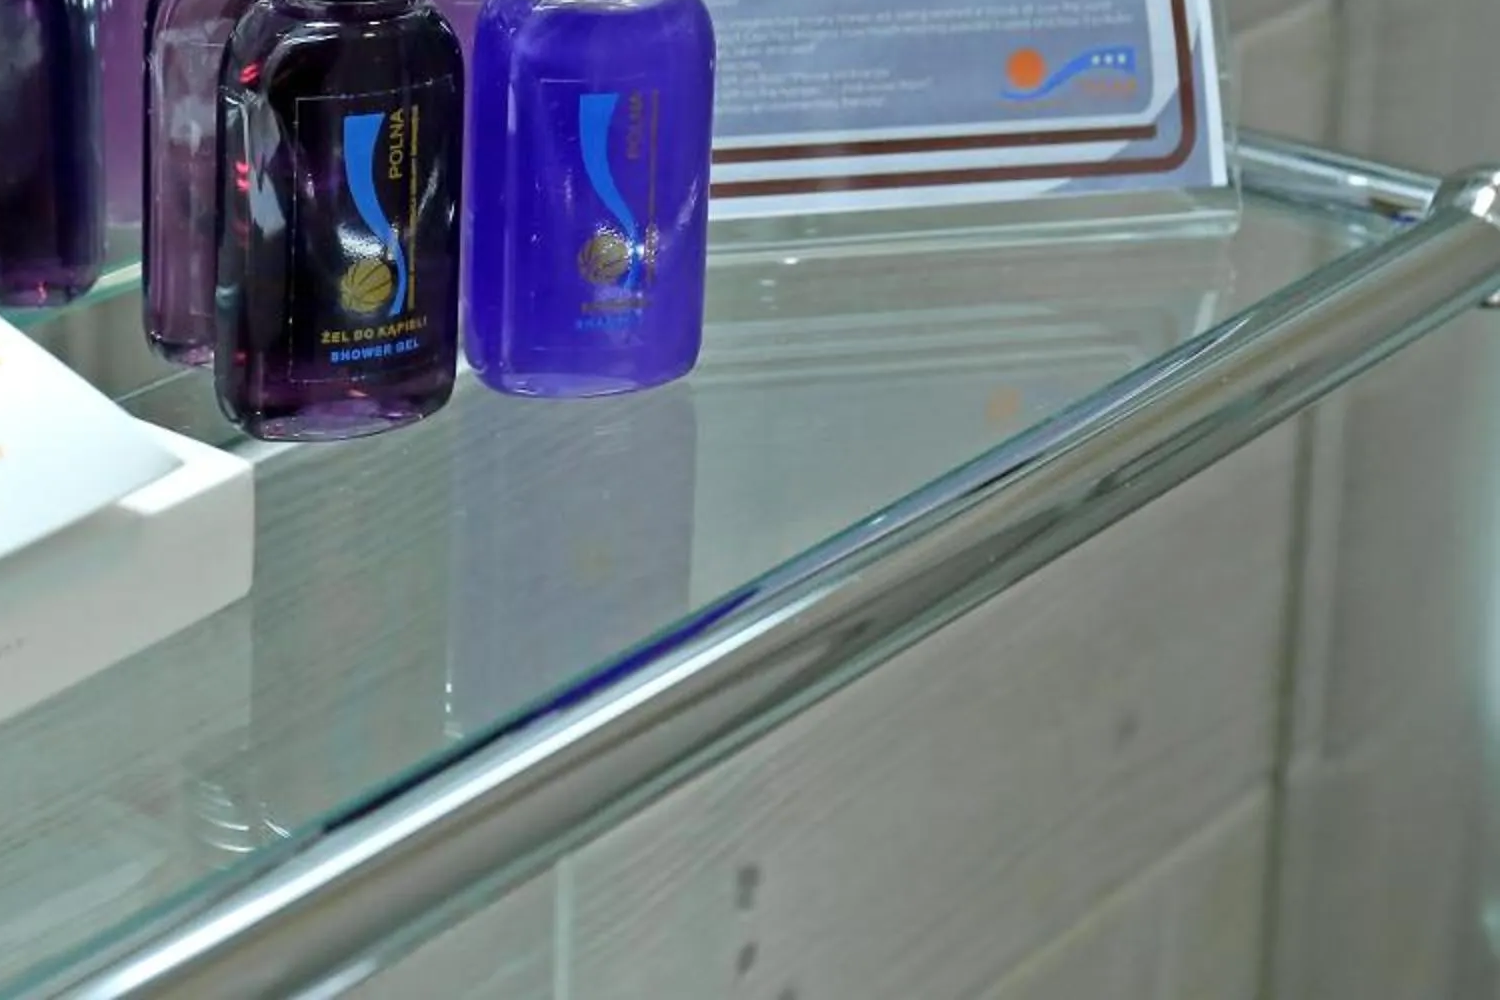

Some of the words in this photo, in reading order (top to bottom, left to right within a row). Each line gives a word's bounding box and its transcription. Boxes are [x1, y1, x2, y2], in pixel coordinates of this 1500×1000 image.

[388, 108, 405, 180] POLNA
[321, 329, 349, 345] ŻEL
[330, 343, 393, 363] SHOWER
[396, 338, 420, 354] GEL
